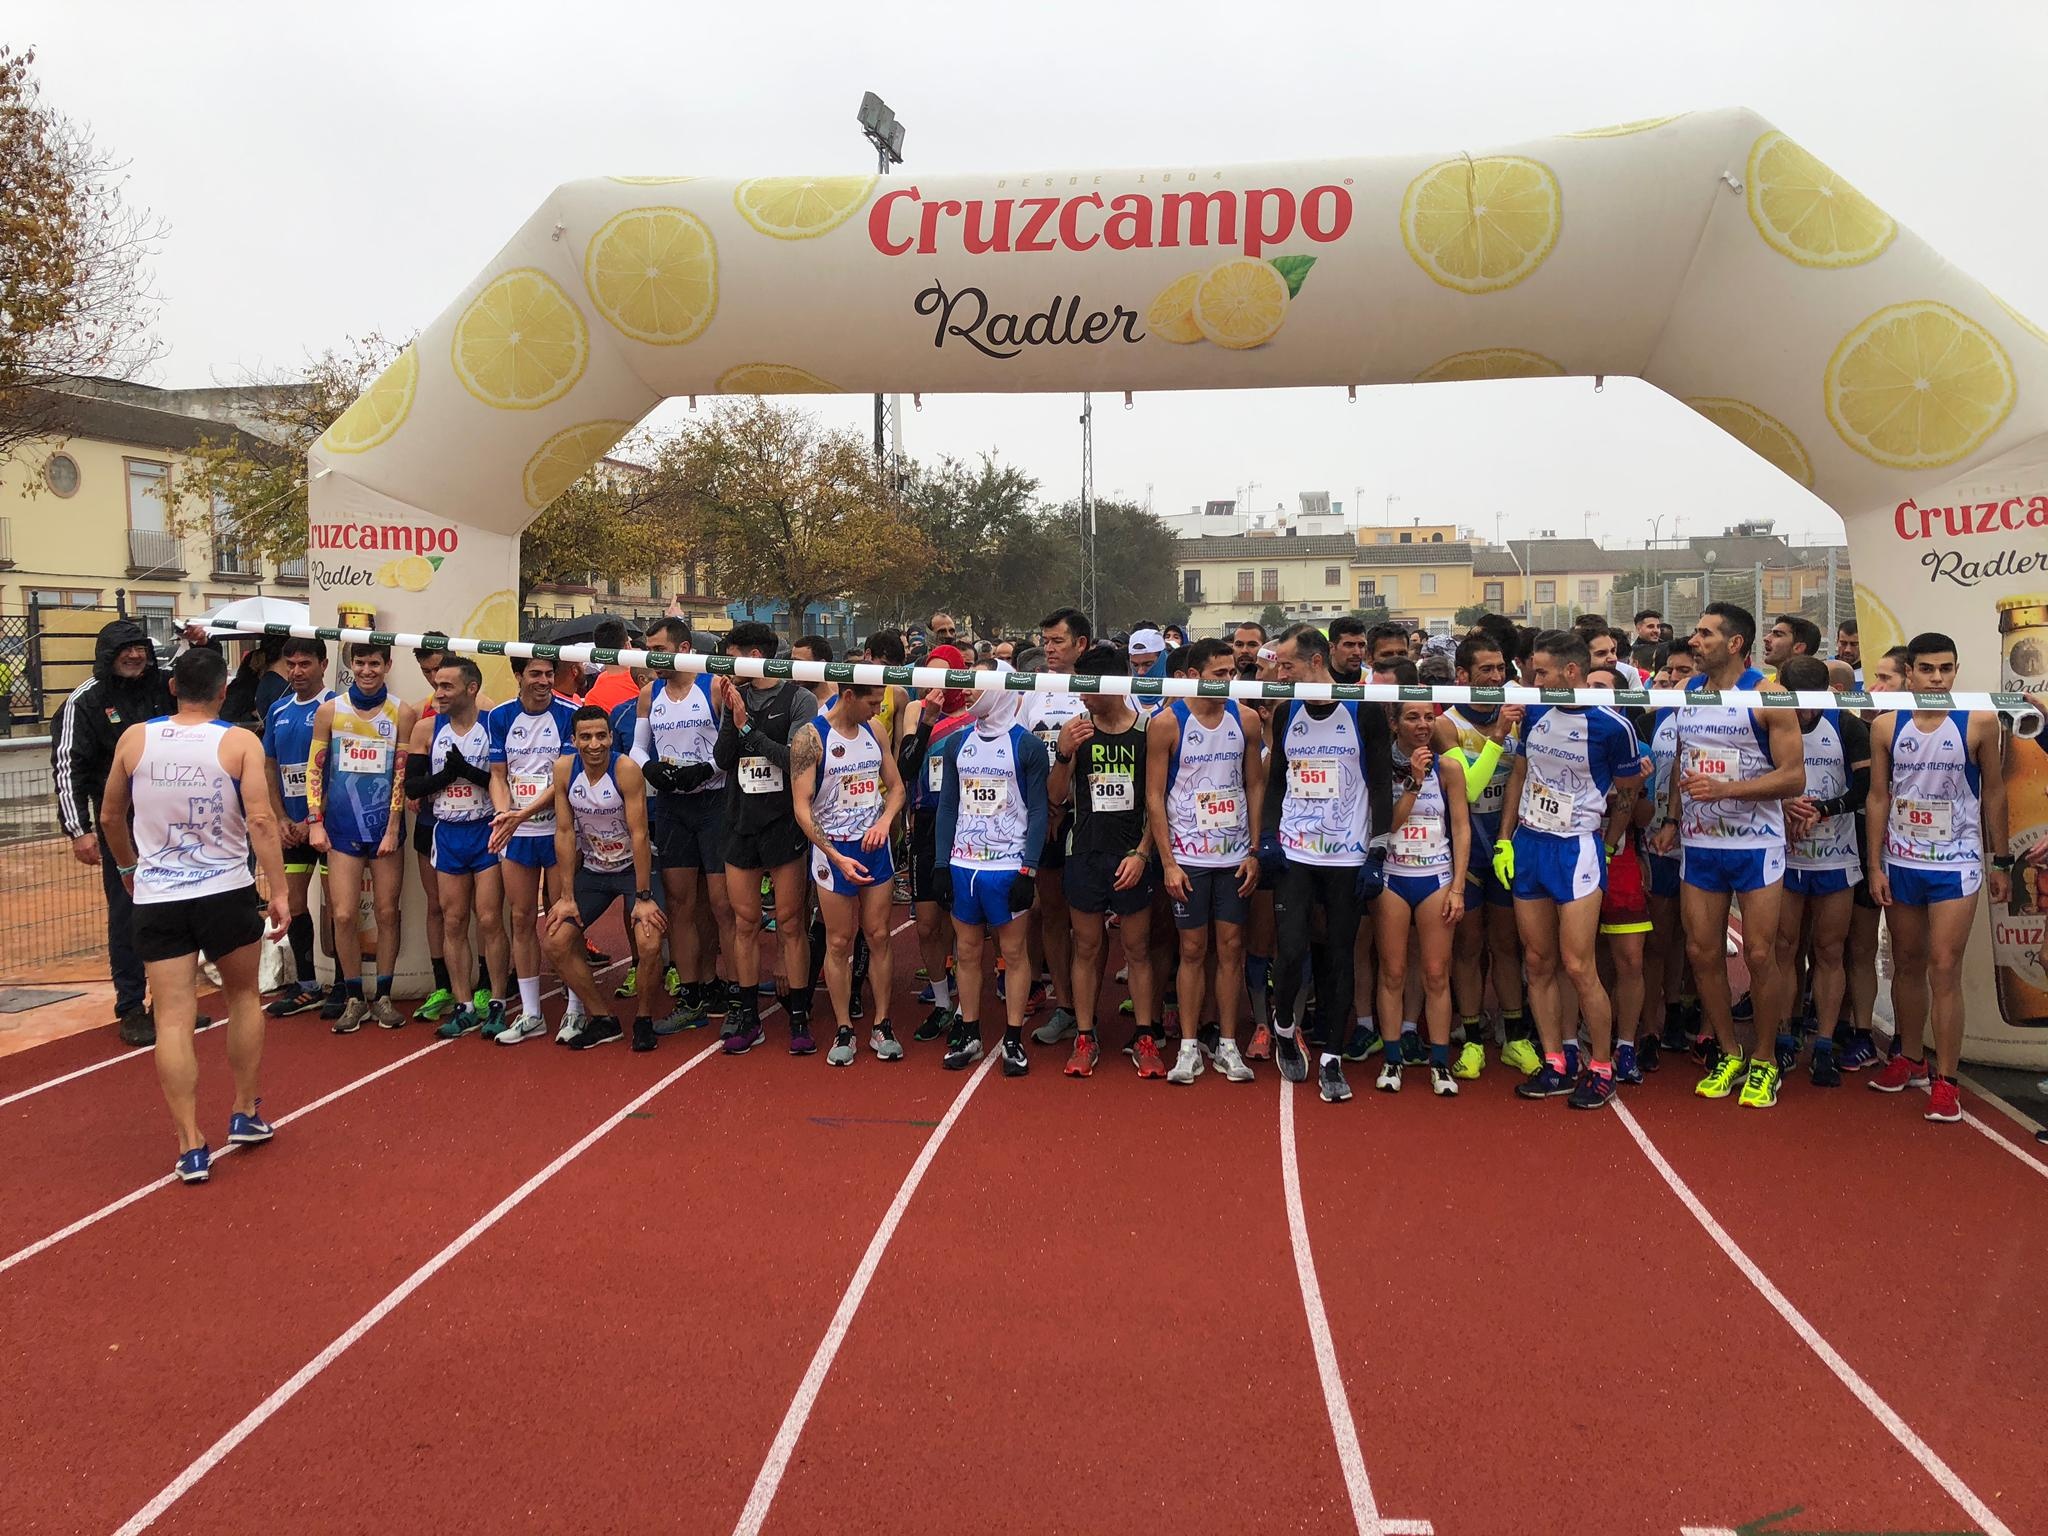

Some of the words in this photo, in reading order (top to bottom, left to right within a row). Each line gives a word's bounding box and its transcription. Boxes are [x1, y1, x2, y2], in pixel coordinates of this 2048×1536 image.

[998, 175, 1102, 189] DESDE
[868, 184, 1354, 259] Cruzcampo
[913, 277, 1146, 359] Radler
[309, 522, 459, 556] ruzcampo
[311, 559, 376, 592] Radler
[676, 719, 711, 730] ATLETISMO
[1704, 724, 1749, 736] ATLETISMO
[350, 748, 377, 760] 600
[1091, 744, 1135, 763] RUN
[1316, 745, 1356, 756] ATLETISMO
[1697, 759, 1726, 774] 139
[1804, 757, 1841, 766] ATLETISMO
[151, 761, 206, 782] LÜZA
[287, 772, 307, 785] 145
[750, 766, 772, 779] 144
[980, 766, 1014, 778] ATLETISMO
[1300, 770, 1327, 784] 551
[446, 785, 473, 798] 553
[515, 783, 537, 796] 130
[849, 780, 875, 796] 539
[971, 788, 996, 801] 133
[1095, 783, 1125, 797] 303
[1207, 799, 1235, 815] 549
[1539, 796, 1560, 815] 113
[1909, 810, 1933, 825] 93
[1680, 812, 1781, 839] ndalucía
[1400, 826, 1427, 840] 121
[2010, 831, 2040, 852] AMPO
[1995, 920, 2044, 946] Cruz
